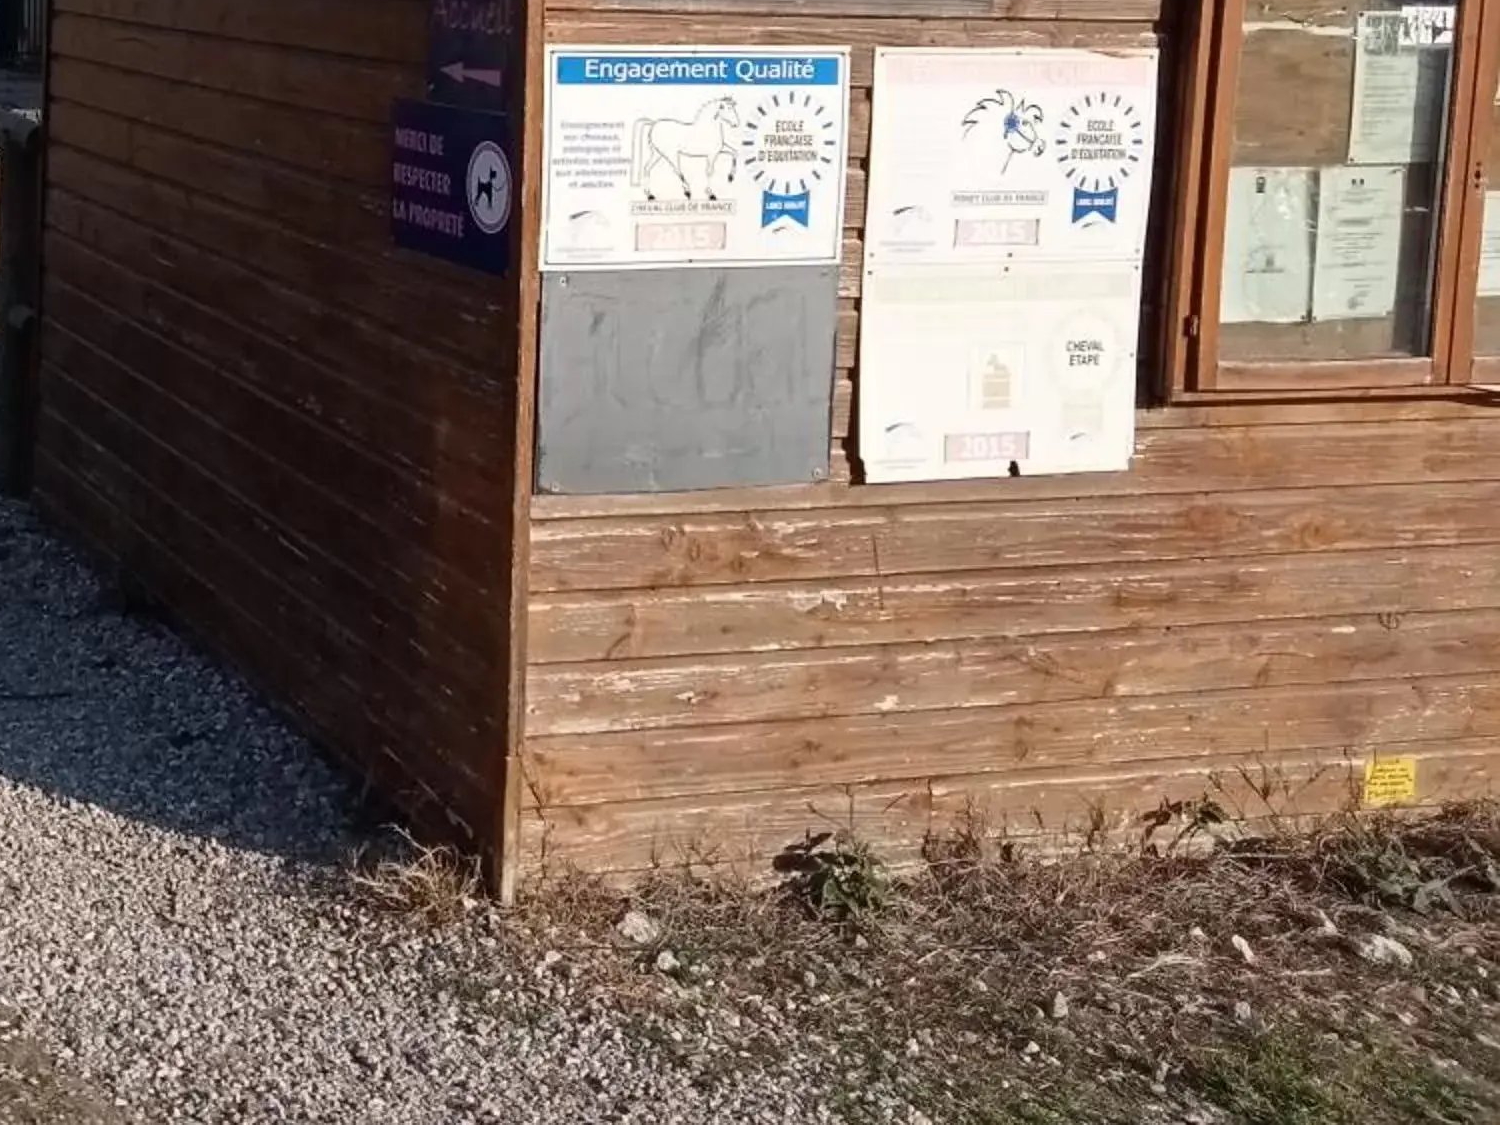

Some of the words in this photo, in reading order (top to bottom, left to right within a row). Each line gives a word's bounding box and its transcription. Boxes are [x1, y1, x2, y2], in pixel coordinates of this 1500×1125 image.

[584, 59, 728, 82] Engagement
[735, 58, 815, 82] Qualité
[775, 120, 804, 133] ECOLE
[1087, 120, 1115, 131] ECOLE
[429, 133, 444, 156] DE
[393, 162, 451, 196] RESPECTER
[393, 197, 406, 220] LA
[1065, 340, 1104, 352] CHEVAL
[1068, 354, 1100, 366] ETAPE
[960, 435, 1017, 459] 2015
